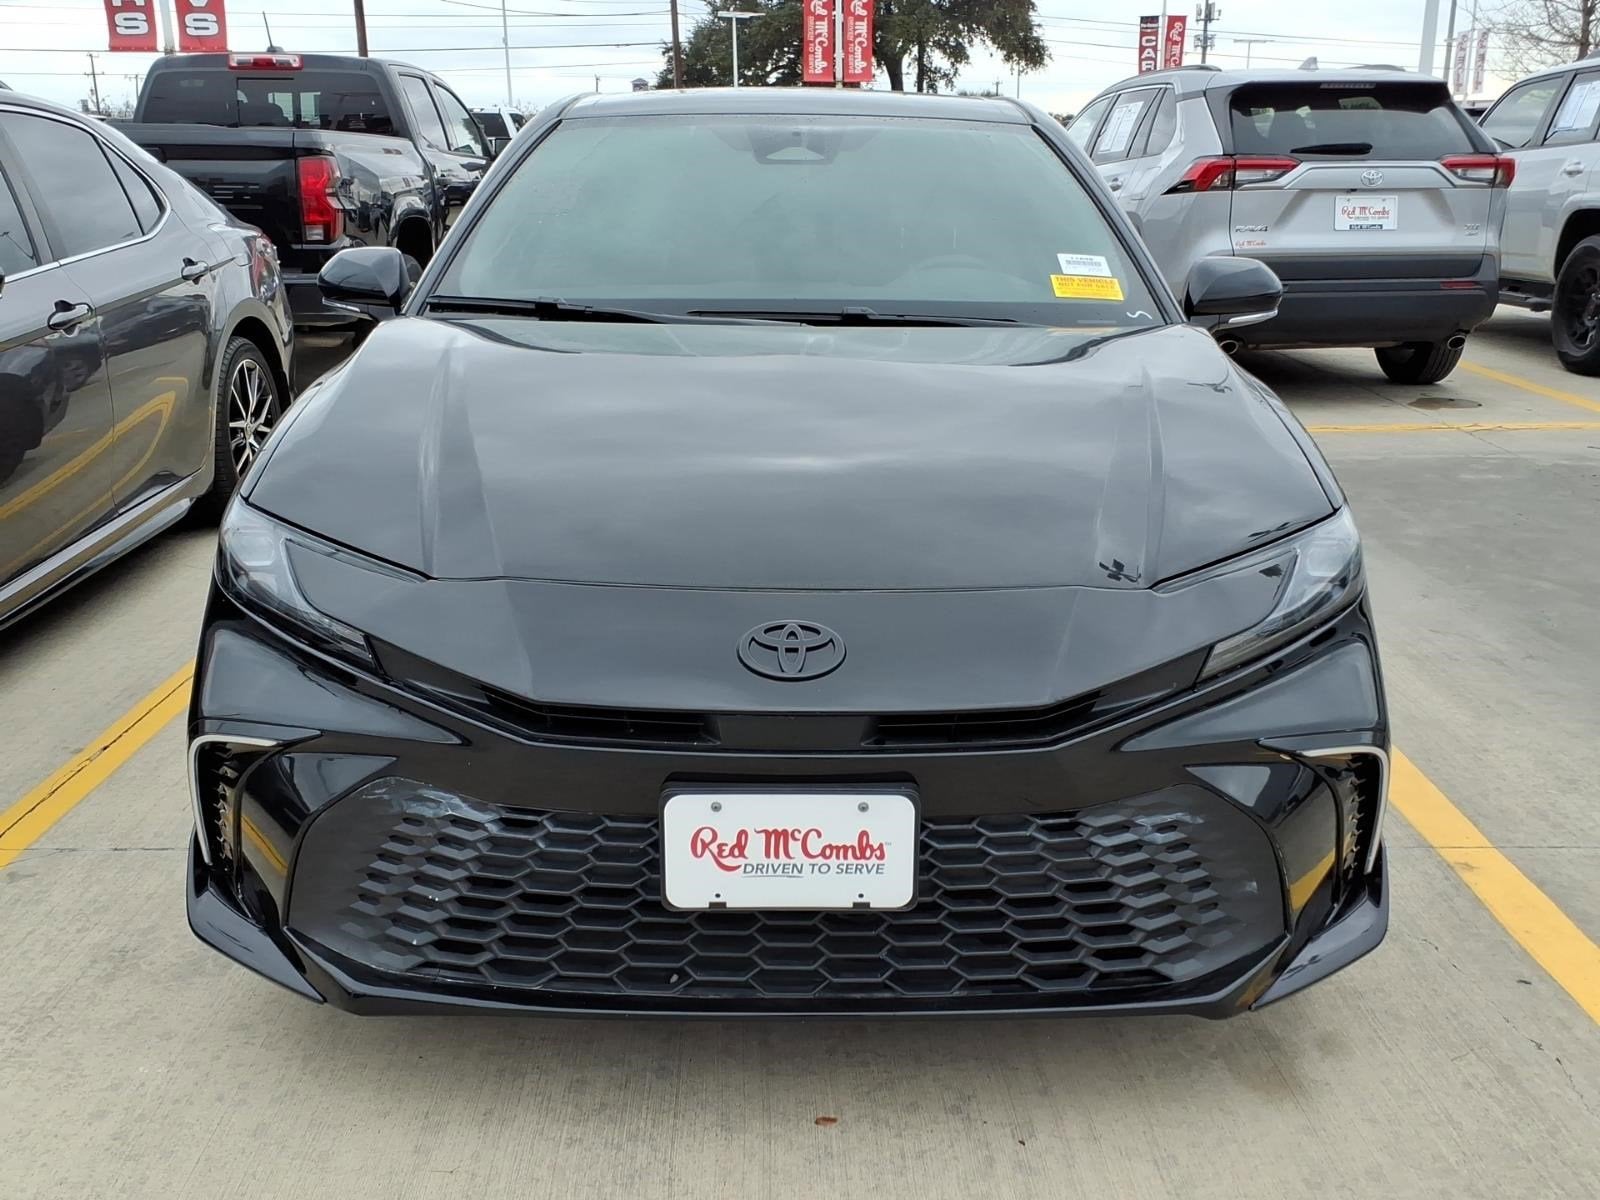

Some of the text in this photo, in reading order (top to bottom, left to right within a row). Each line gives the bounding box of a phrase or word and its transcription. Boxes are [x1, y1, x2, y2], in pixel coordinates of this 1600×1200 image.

[815, 17, 829, 74] McCombs
[855, 17, 868, 74] McCombs
[690, 826, 886, 872] Red McCombs
[743, 863, 886, 876] DRIVEN TO SERVE
